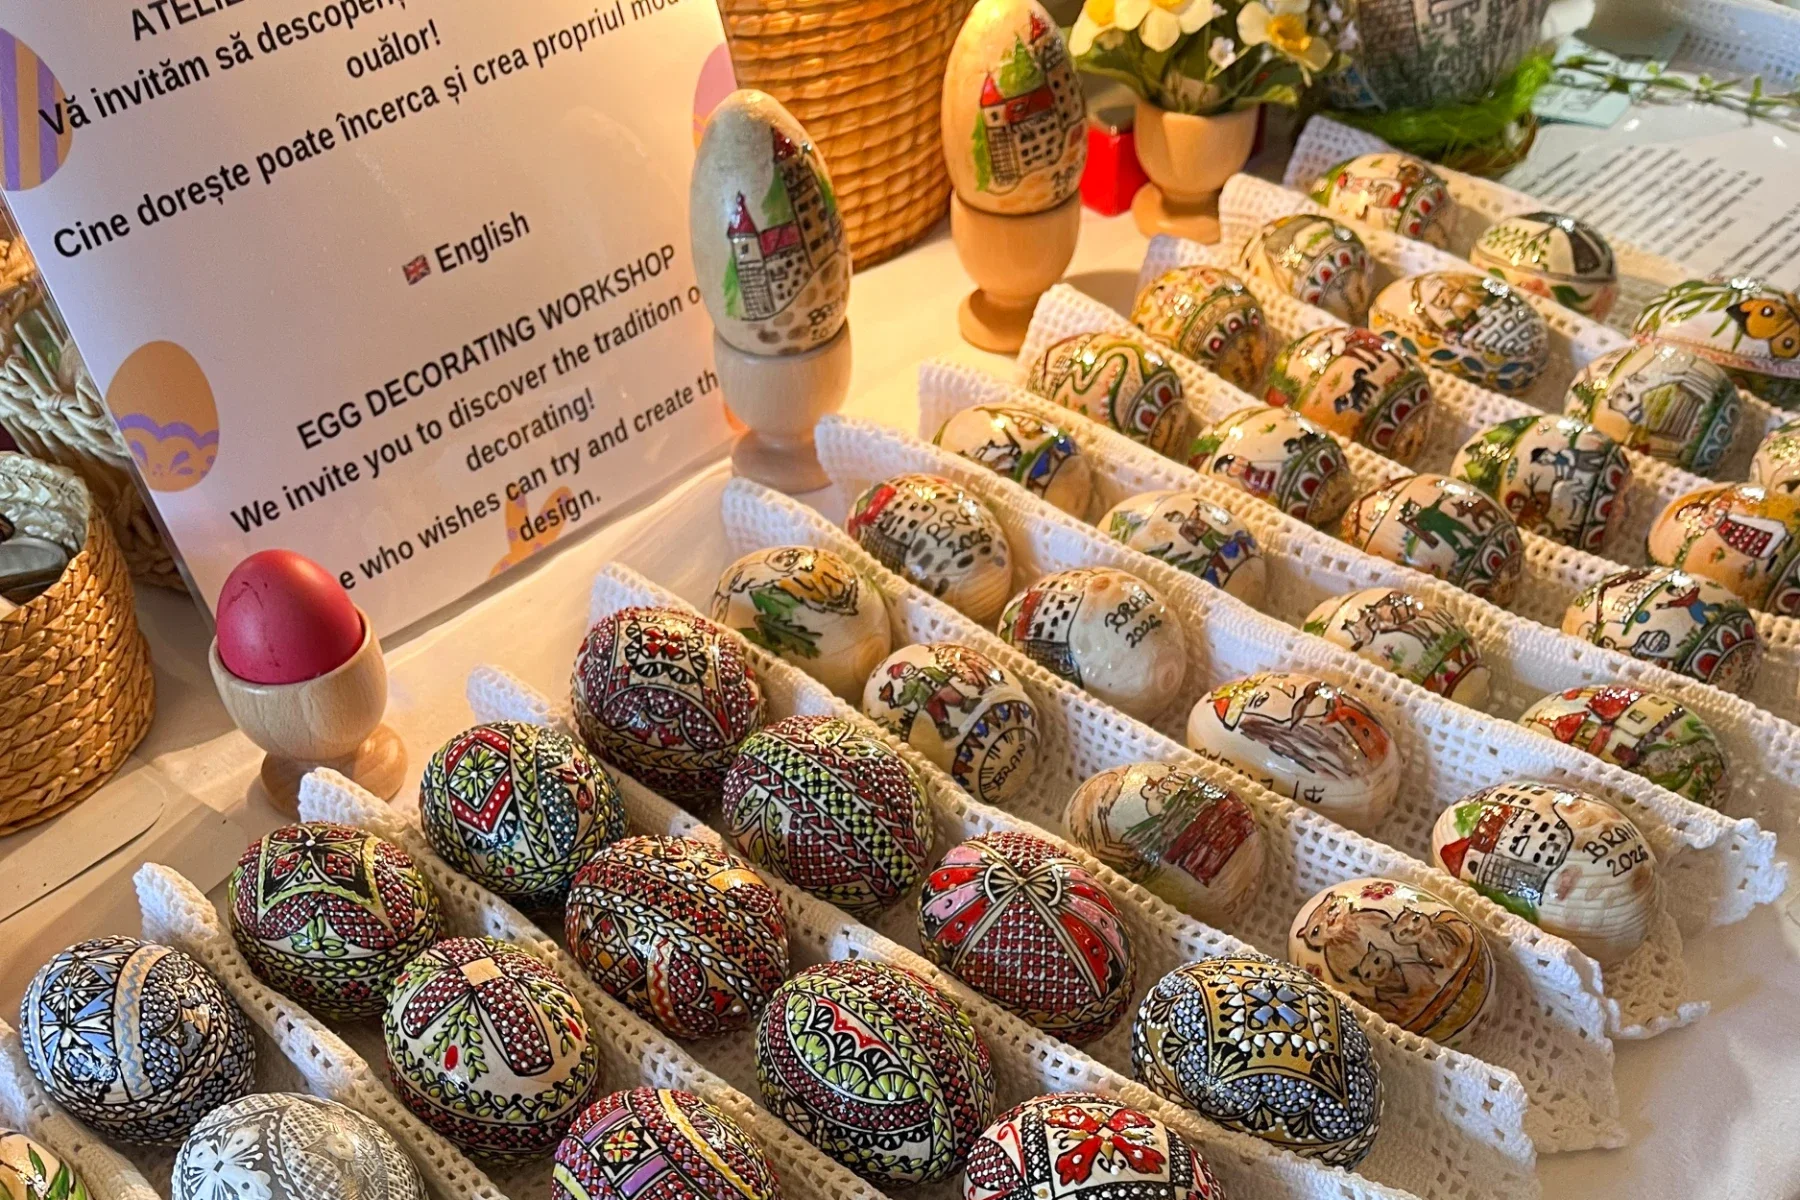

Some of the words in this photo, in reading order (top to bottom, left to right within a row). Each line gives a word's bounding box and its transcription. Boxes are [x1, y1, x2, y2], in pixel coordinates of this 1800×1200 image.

[38, 95, 91, 135] Vă
[90, 58, 210, 118] invităm
[215, 31, 254, 70] să
[257, 0, 406, 54] descope
[132, 0, 244, 42] ATEL
[346, 18, 441, 79] ouălor!
[54, 212, 130, 258] Cine
[137, 162, 251, 226] dorește
[256, 126, 336, 184] poate
[335, 85, 440, 142] încerca
[443, 64, 467, 105] și
[473, 47, 529, 85] crea
[532, 0, 625, 68] propriul
[631, 0, 679, 21] mo
[435, 211, 530, 273] English
[296, 401, 362, 450] EGG
[365, 315, 536, 417] DECORATING
[538, 244, 675, 331] WORKSHOP
[230, 499, 281, 534] We
[282, 461, 360, 511] invite
[363, 434, 413, 479] you
[416, 419, 442, 445] to
[448, 363, 547, 430] discover
[552, 343, 592, 375] the
[593, 294, 683, 354] tradition
[687, 285, 700, 304] o
[465, 387, 596, 472] decorating!
[359, 540, 414, 579] who
[417, 492, 500, 549] wishes
[505, 465, 547, 502] can
[550, 447, 580, 477] try
[587, 417, 628, 458] and
[633, 386, 694, 433] create
[697, 367, 719, 395] th
[519, 487, 602, 542] design.
